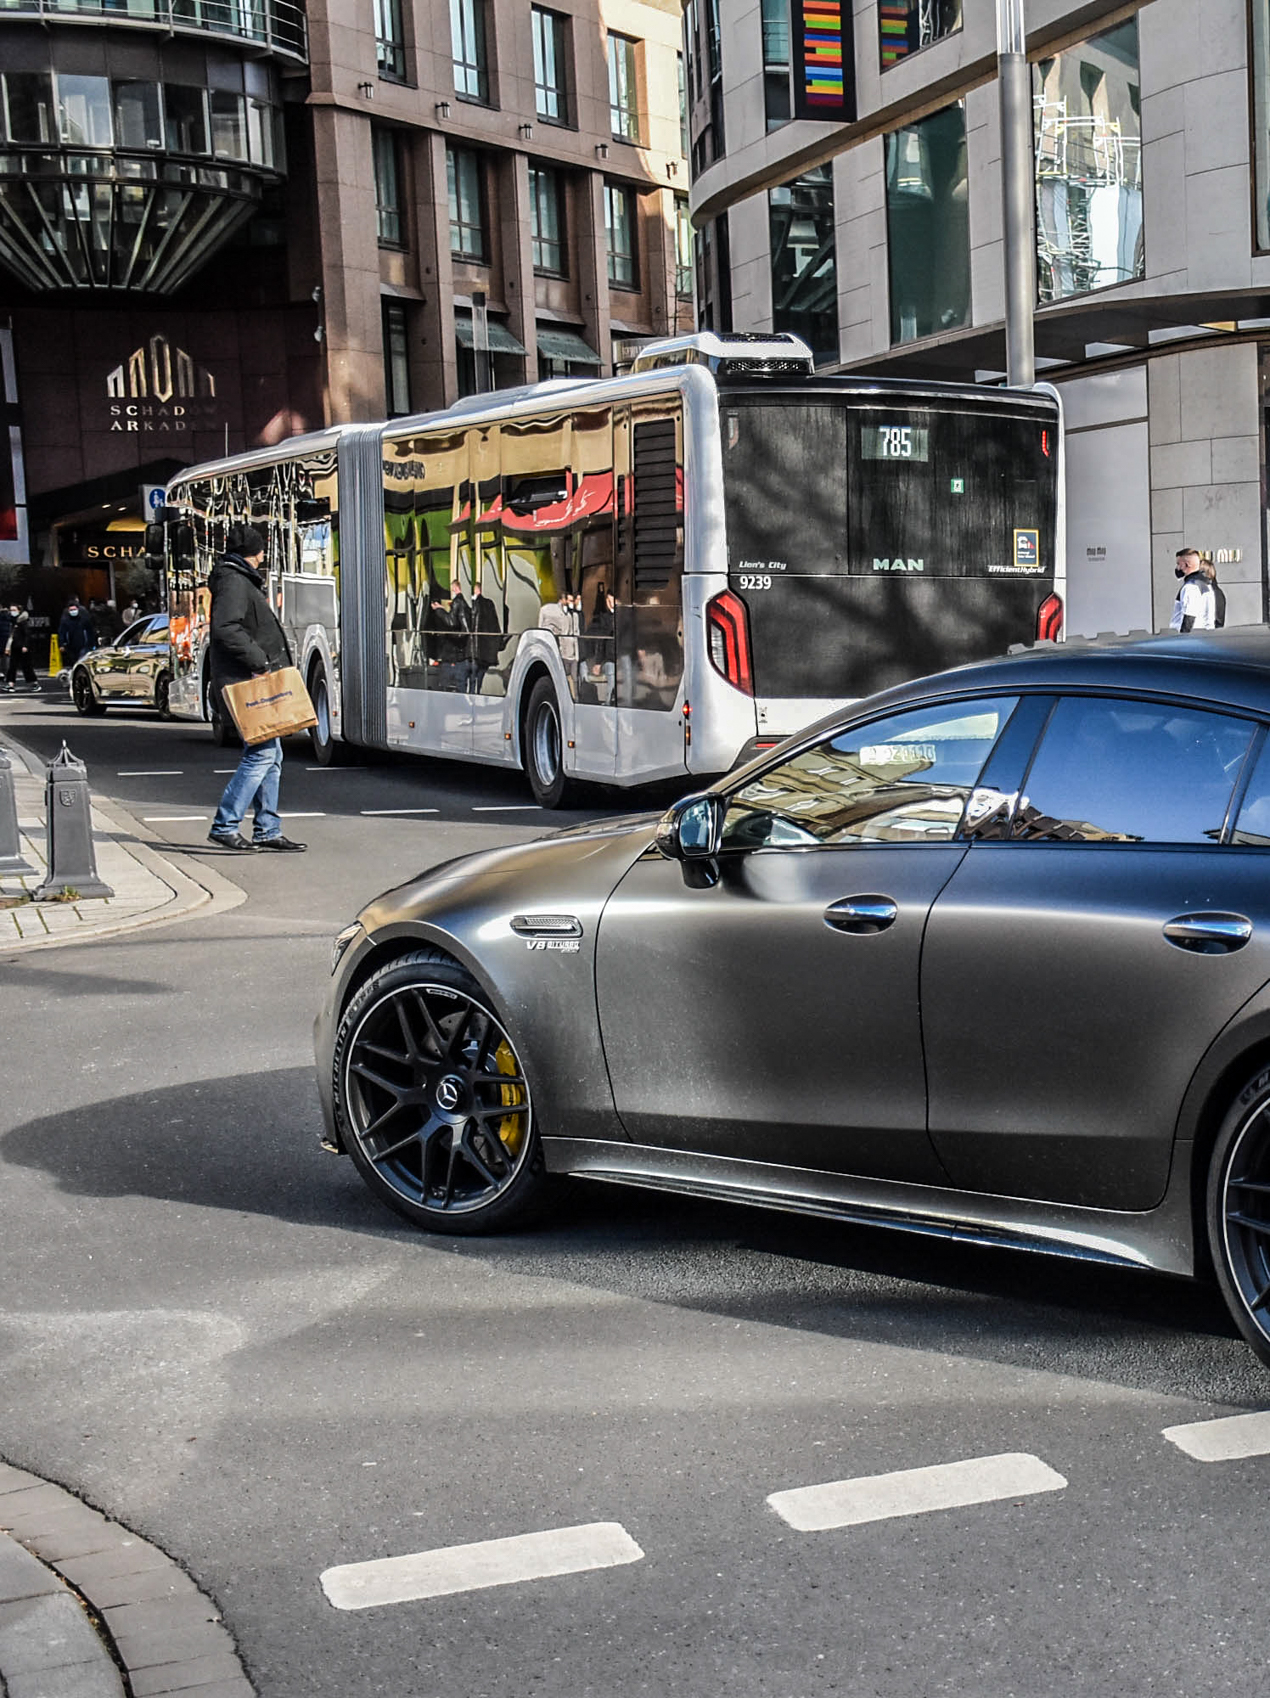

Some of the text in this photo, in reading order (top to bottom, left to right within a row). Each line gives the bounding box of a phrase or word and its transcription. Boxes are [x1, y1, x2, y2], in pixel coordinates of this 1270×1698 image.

[879, 426, 912, 457] 785
[739, 561, 787, 571] Lion's City
[873, 558, 924, 571] MAN
[740, 575, 772, 590] 9239
[526, 941, 546, 950] V8
